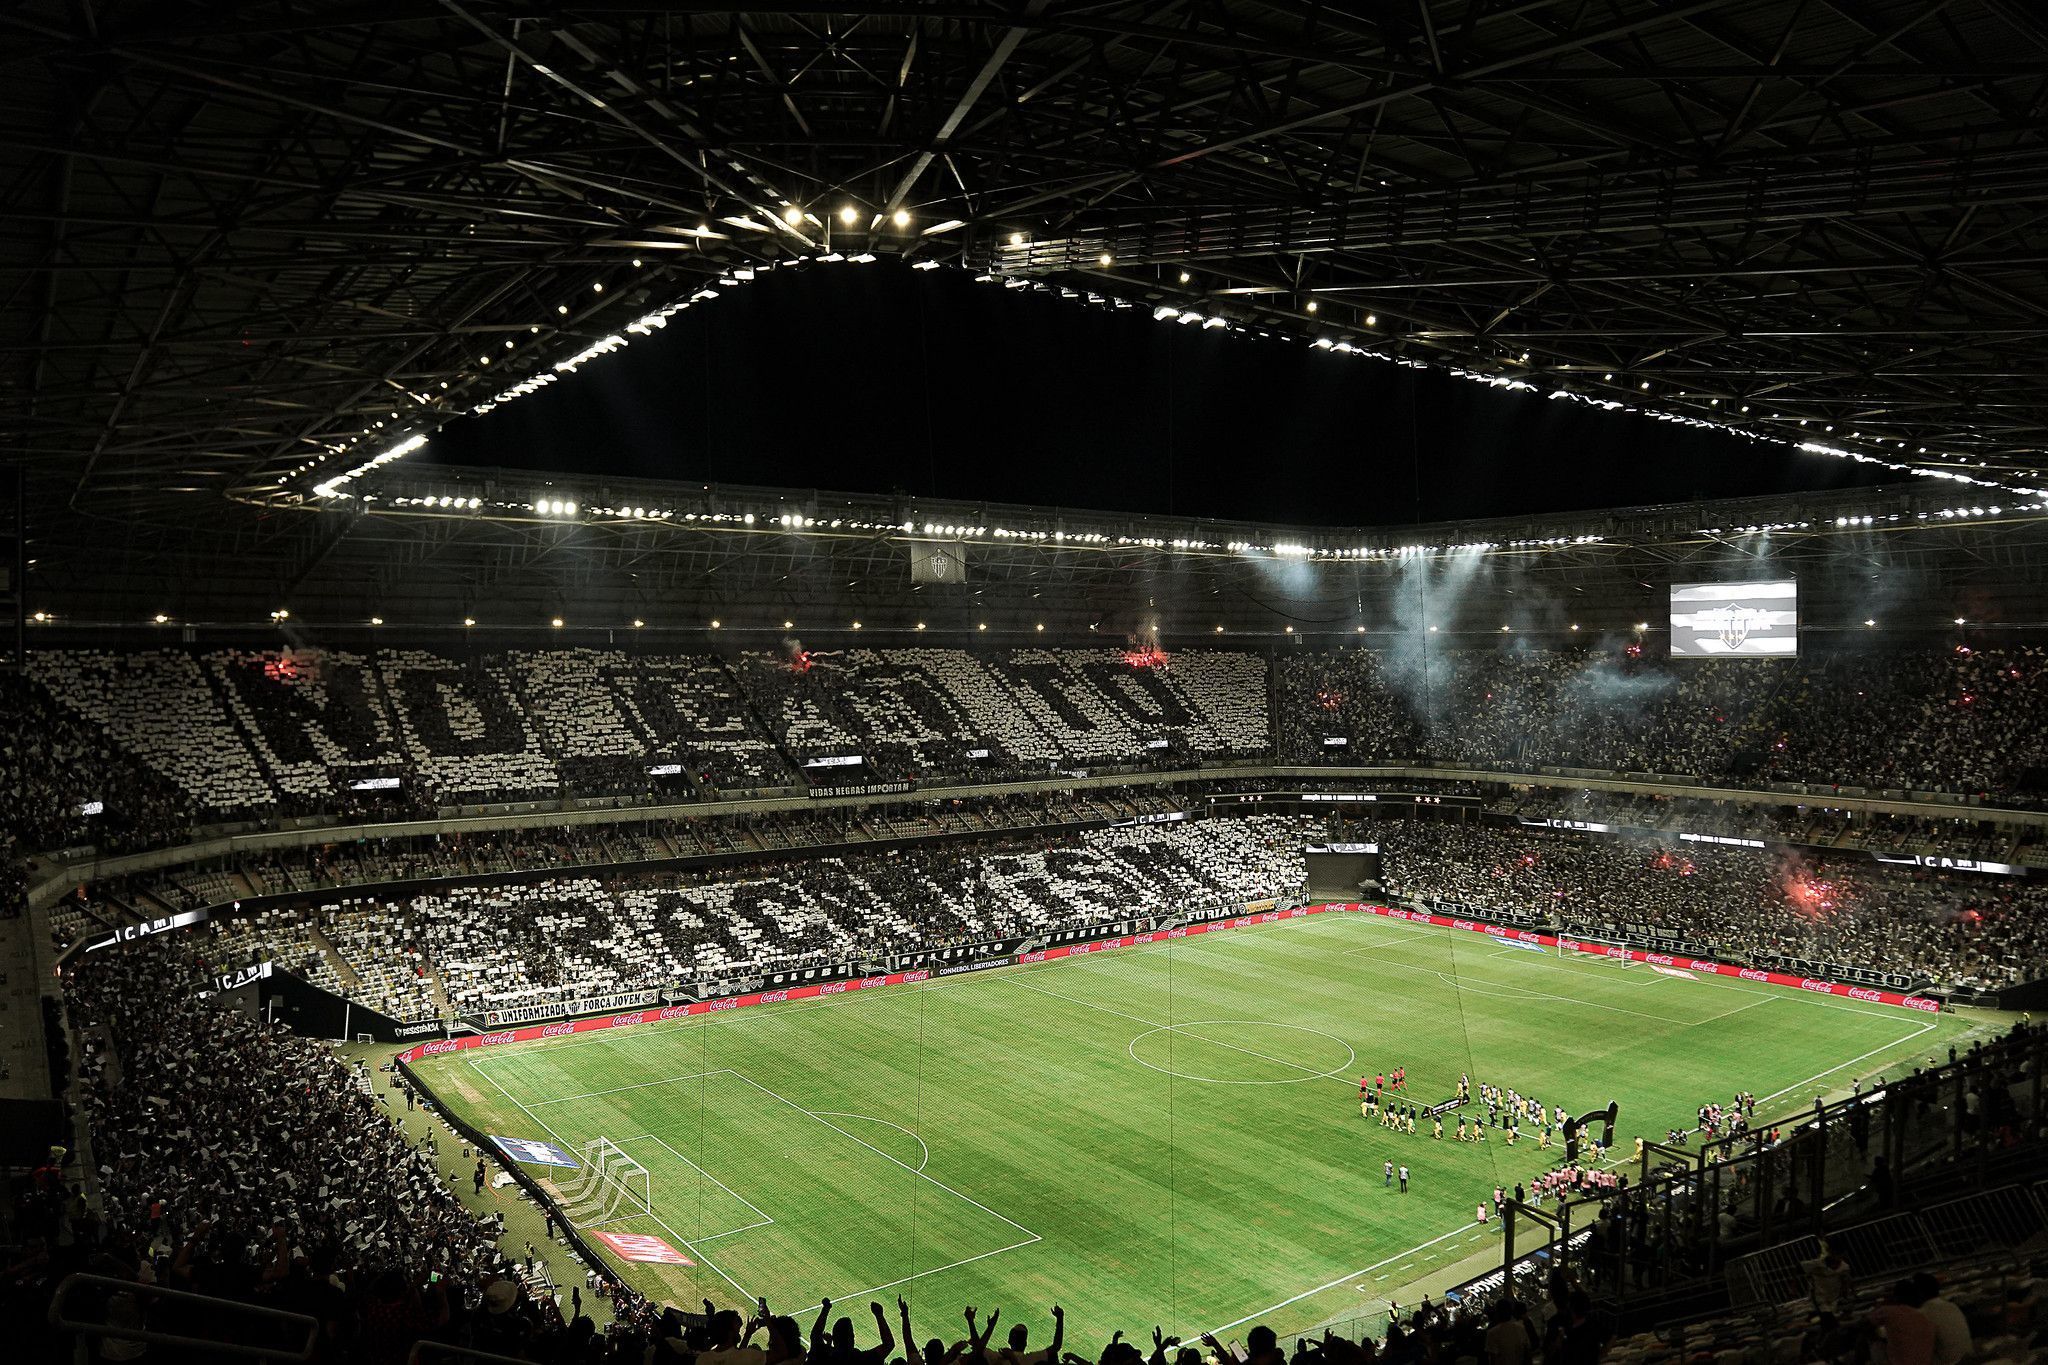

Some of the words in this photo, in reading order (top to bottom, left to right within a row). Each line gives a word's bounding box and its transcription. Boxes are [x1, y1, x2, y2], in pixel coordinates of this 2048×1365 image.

[809, 787, 834, 798] VIDAS
[835, 785, 866, 796] NEGRAS
[867, 782, 909, 794] IMPORTAM
[1924, 856, 1972, 868] CAM
[1187, 907, 1231, 922] FURIA
[124, 917, 167, 940] CAM
[773, 965, 847, 984] CLUBE
[939, 963, 969, 976] CONMEBOL
[971, 958, 1009, 972] LIBERTADORES
[222, 967, 258, 990] CAM
[613, 994, 641, 1008] JOVEM
